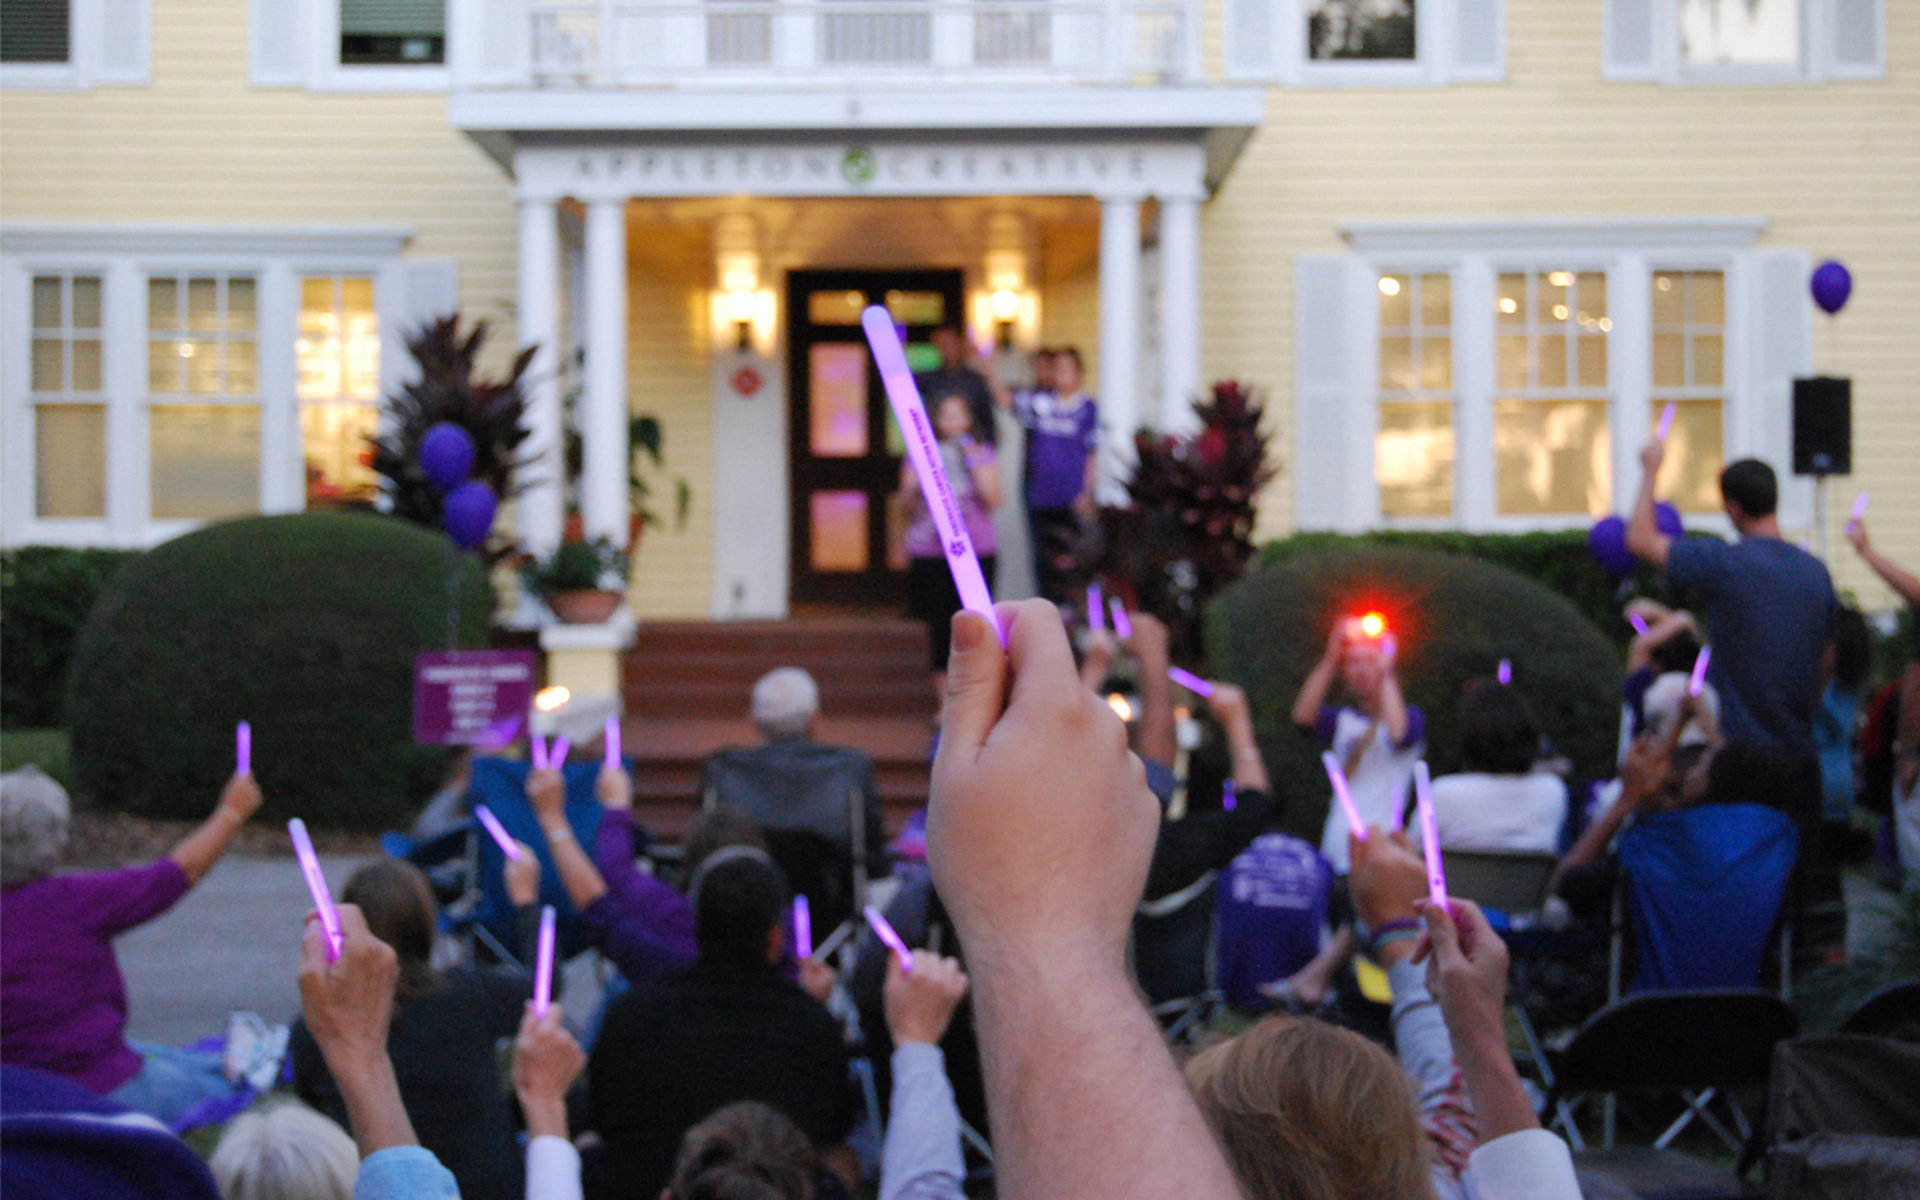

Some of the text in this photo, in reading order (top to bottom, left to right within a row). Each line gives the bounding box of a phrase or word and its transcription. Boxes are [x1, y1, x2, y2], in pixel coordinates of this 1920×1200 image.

[575, 150, 1147, 181] APPLETON CREATIVE
[931, 469, 946, 496] CANCER
